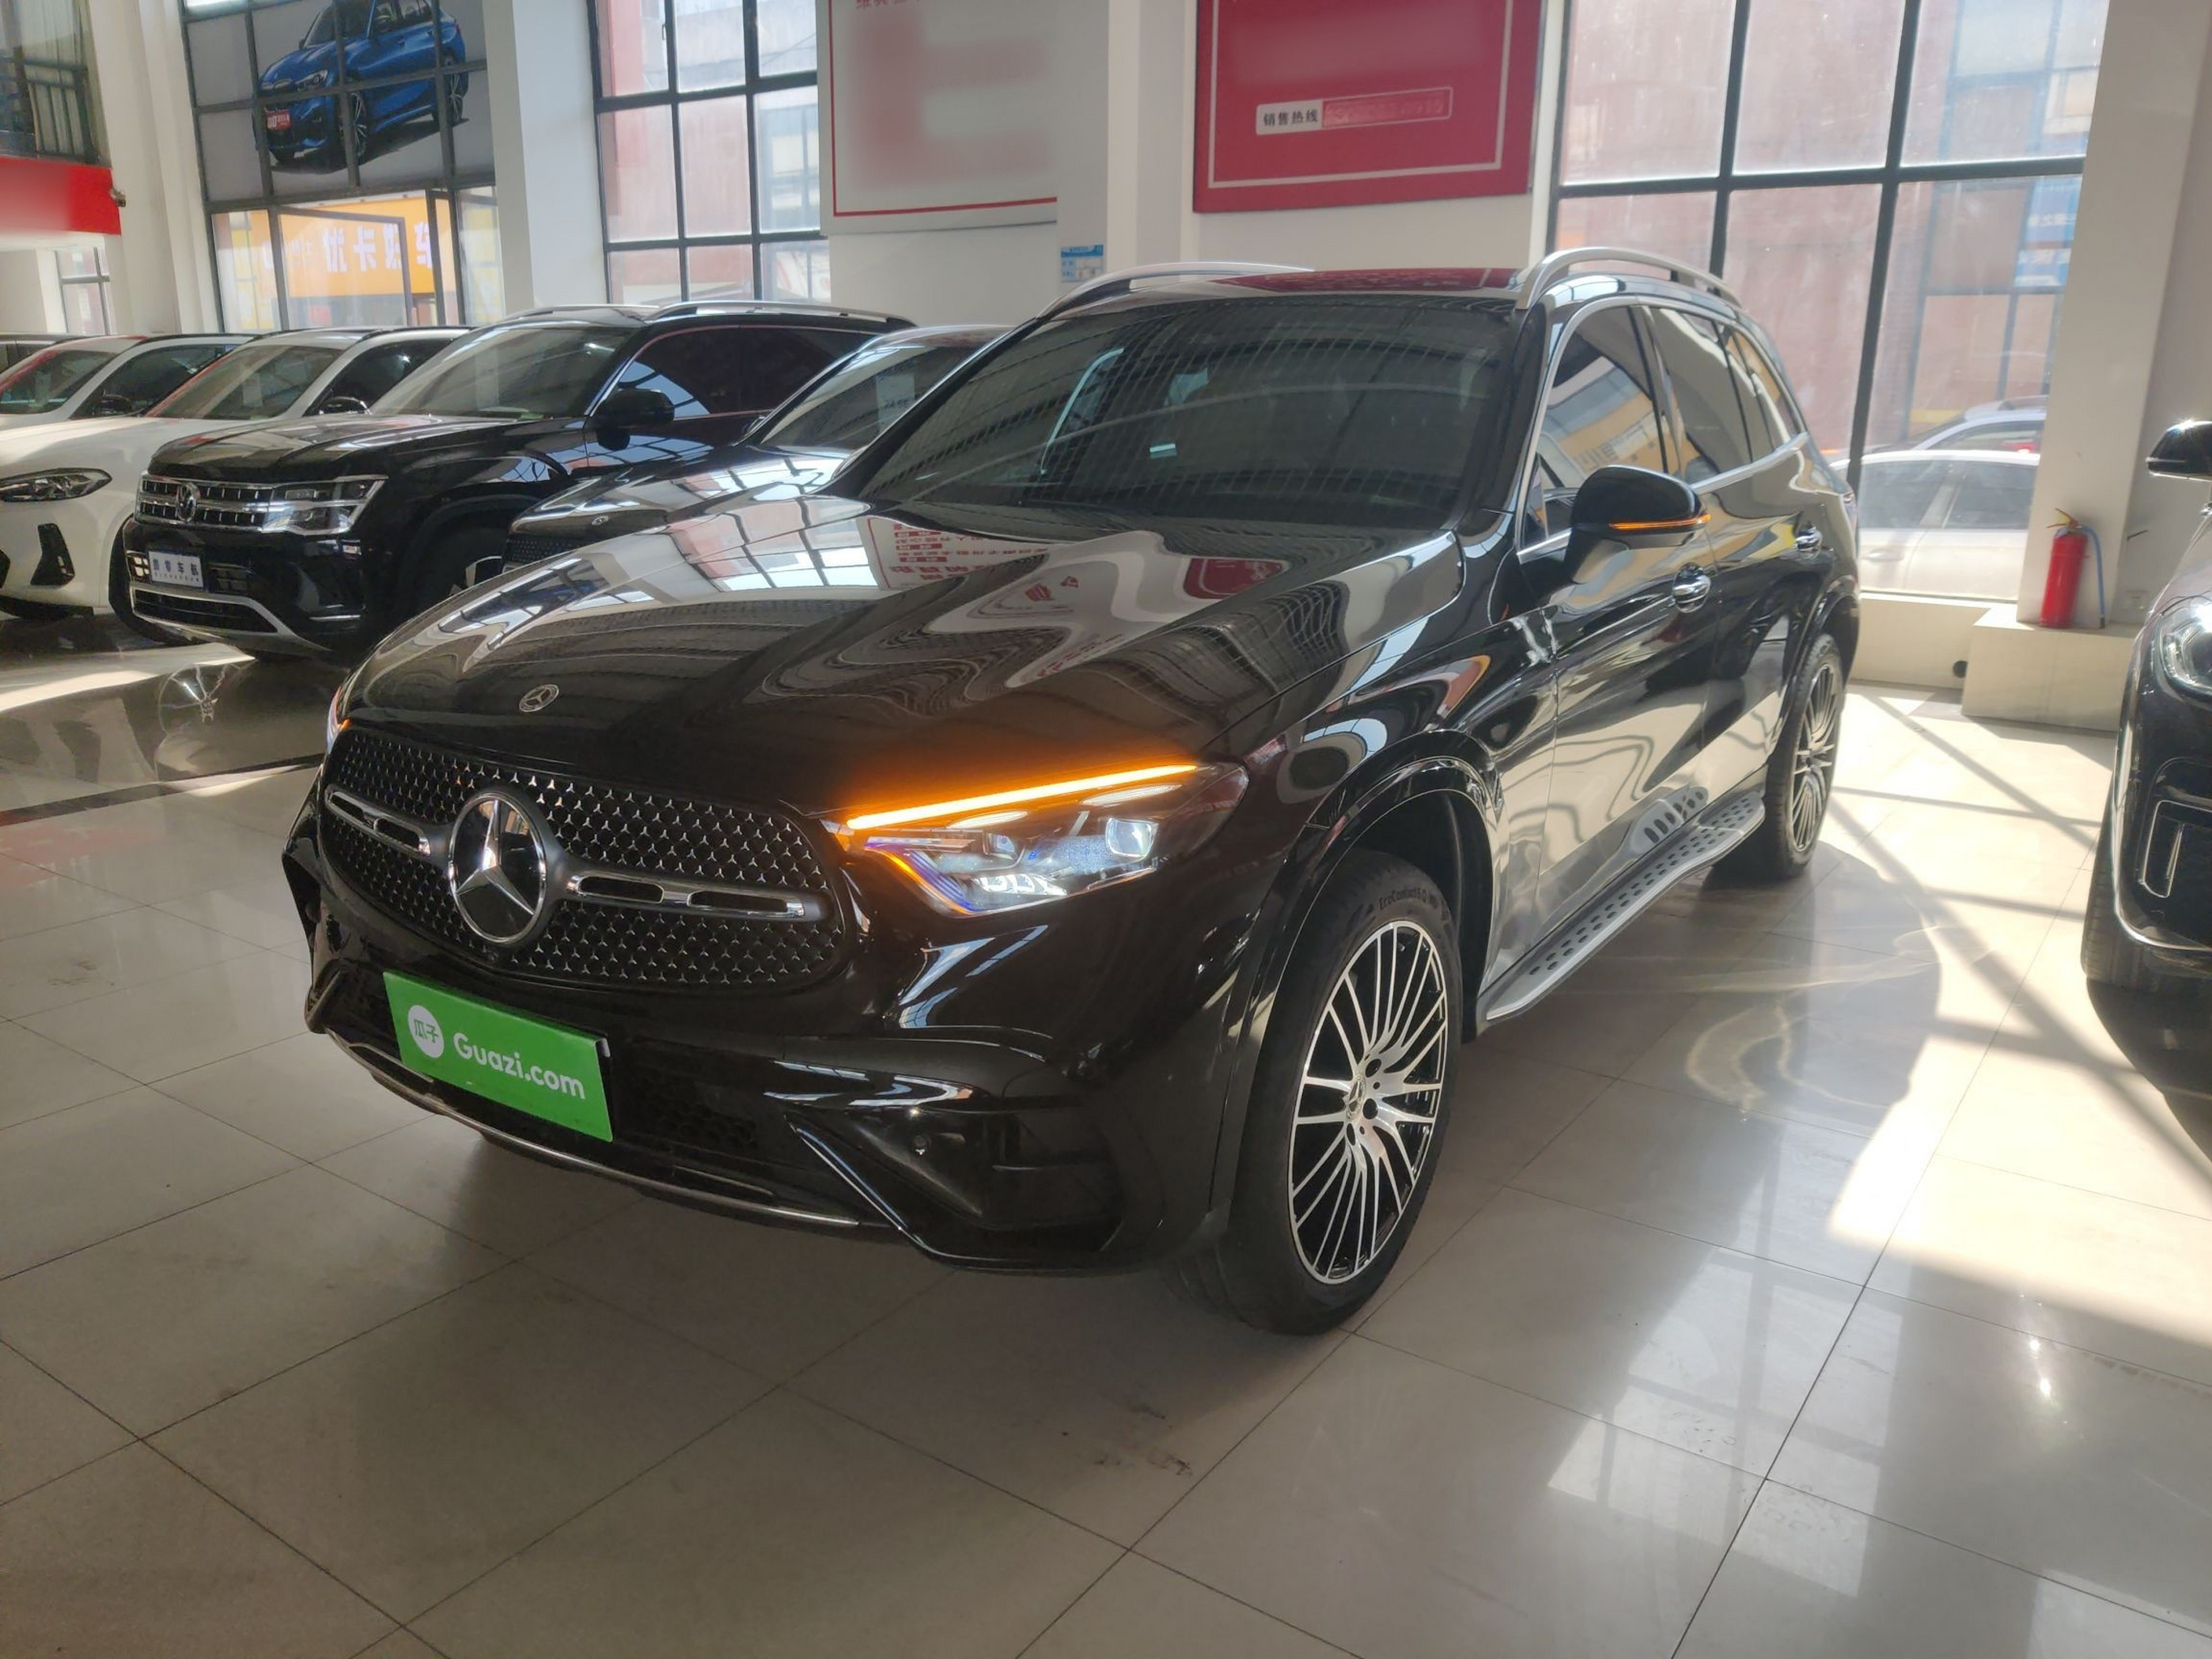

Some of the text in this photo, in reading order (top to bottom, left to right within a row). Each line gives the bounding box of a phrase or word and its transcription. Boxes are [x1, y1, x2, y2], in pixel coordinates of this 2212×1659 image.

[1263, 109, 1318, 127] 销售热线
[414, 1019, 438, 1043] 瓜子
[453, 1032, 586, 1100] Guazi.com
